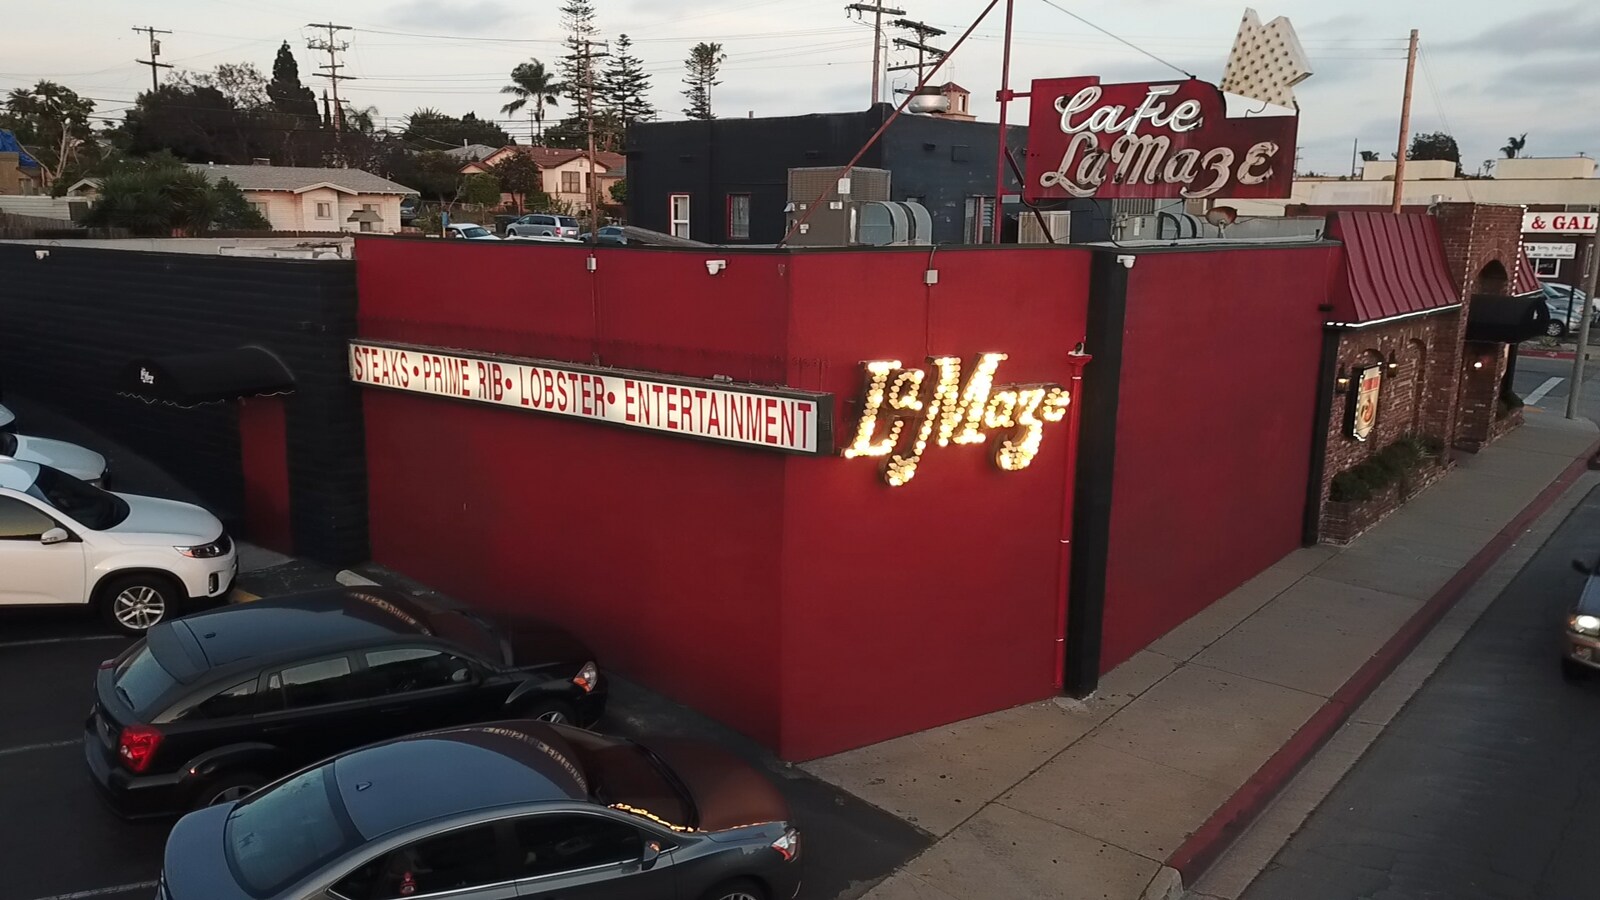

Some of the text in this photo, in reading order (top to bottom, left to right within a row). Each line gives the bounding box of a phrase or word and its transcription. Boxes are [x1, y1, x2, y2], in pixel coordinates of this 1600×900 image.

[1531, 215, 1594, 230] & GAL
[354, 346, 812, 448] STEAKS PRIME RIB LOBSTER ENTERTAINMENT
